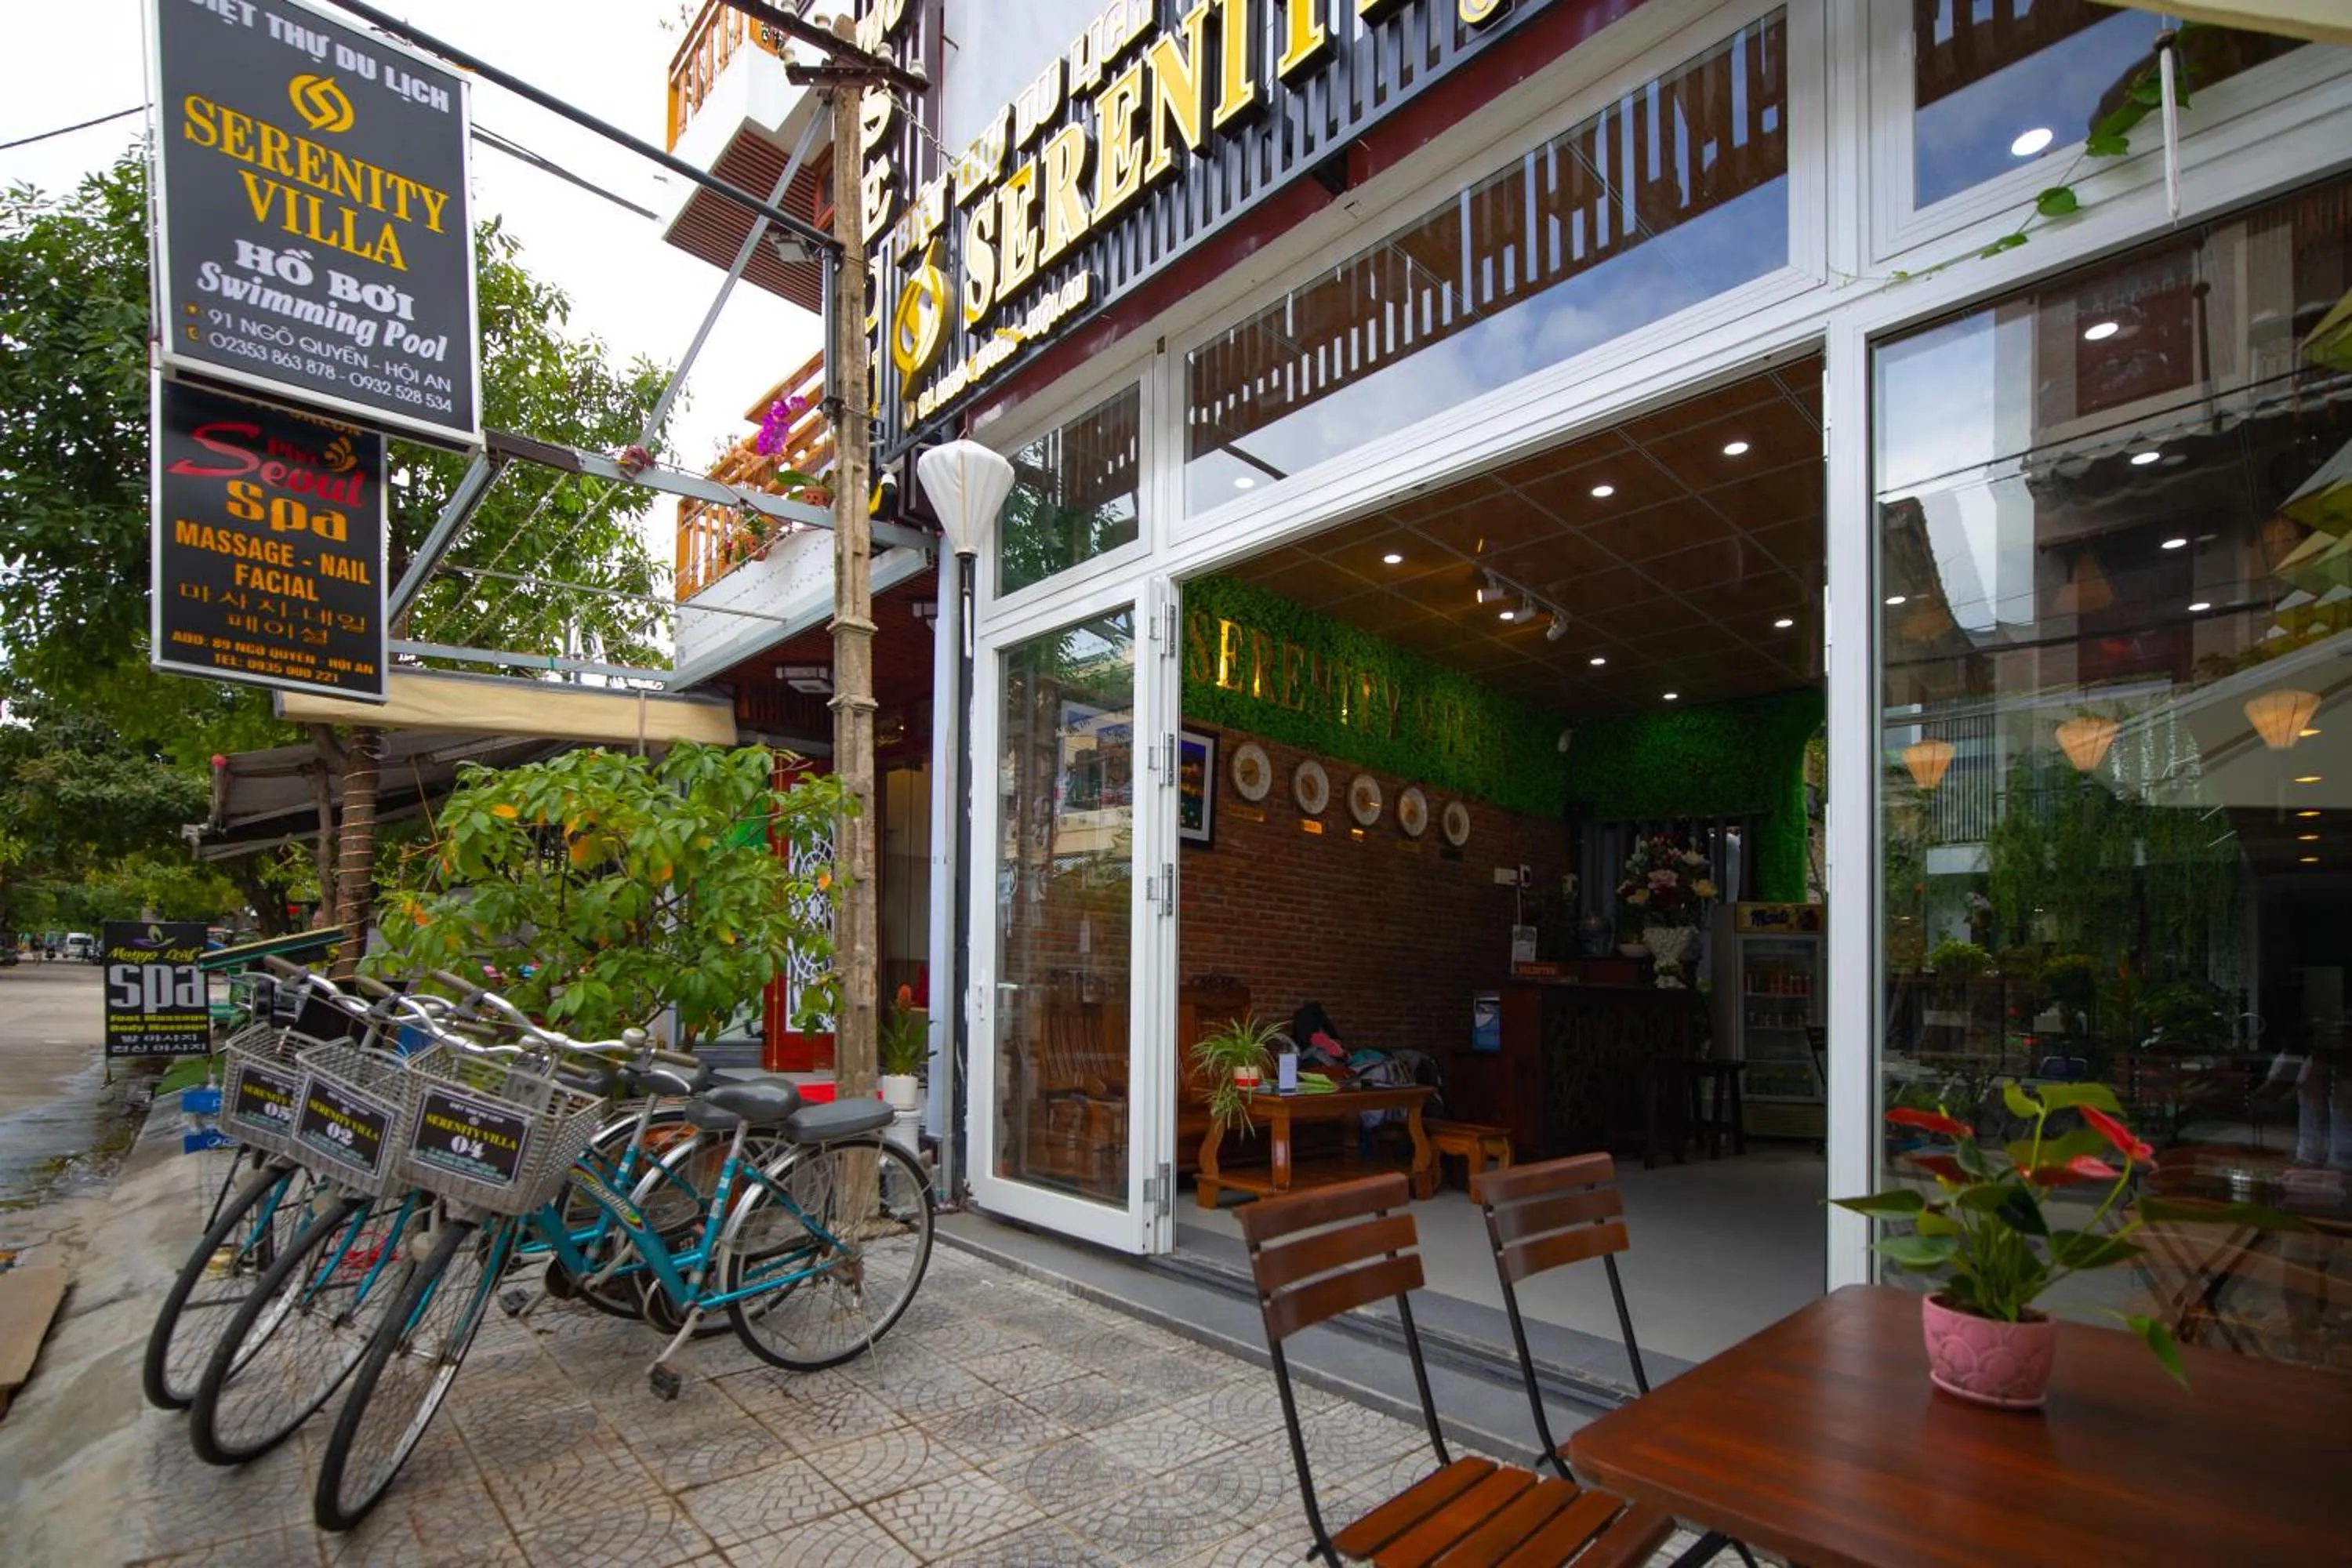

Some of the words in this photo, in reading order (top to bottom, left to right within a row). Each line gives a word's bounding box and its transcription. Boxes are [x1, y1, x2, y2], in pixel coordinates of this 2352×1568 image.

[265, 12, 329, 63] THỰ
[336, 44, 376, 80] DU
[385, 65, 450, 114] LỊCH
[1016, 57, 1061, 150] DU
[183, 94, 450, 234] SERENITY
[238, 169, 408, 271] VILLA
[197, 261, 378, 347] Swimming
[383, 320, 448, 361] Pool
[234, 239, 314, 286] HỒ
[328, 270, 416, 321] BƠI
[208, 308, 232, 329] 91
[240, 318, 295, 347] NGÔ
[385, 361, 419, 385] HỘI
[423, 373, 452, 394] AN
[209, 332, 268, 361] 02353
[271, 349, 302, 371] 863
[306, 358, 336, 380] 878
[350, 372, 391, 396] 0932
[394, 384, 423, 404] 528
[426, 393, 452, 413] 534
[165, 422, 366, 508] Seoul
[226, 479, 348, 542] Spa
[176, 520, 295, 568] MASSAGE
[320, 553, 371, 586] NAIL
[235, 564, 320, 602] FACIAL
[213, 652, 244, 667] TEL:
[109, 964, 206, 1014] spa
[326, 1123, 354, 1145] 02
[451, 1135, 485, 1160] 04
